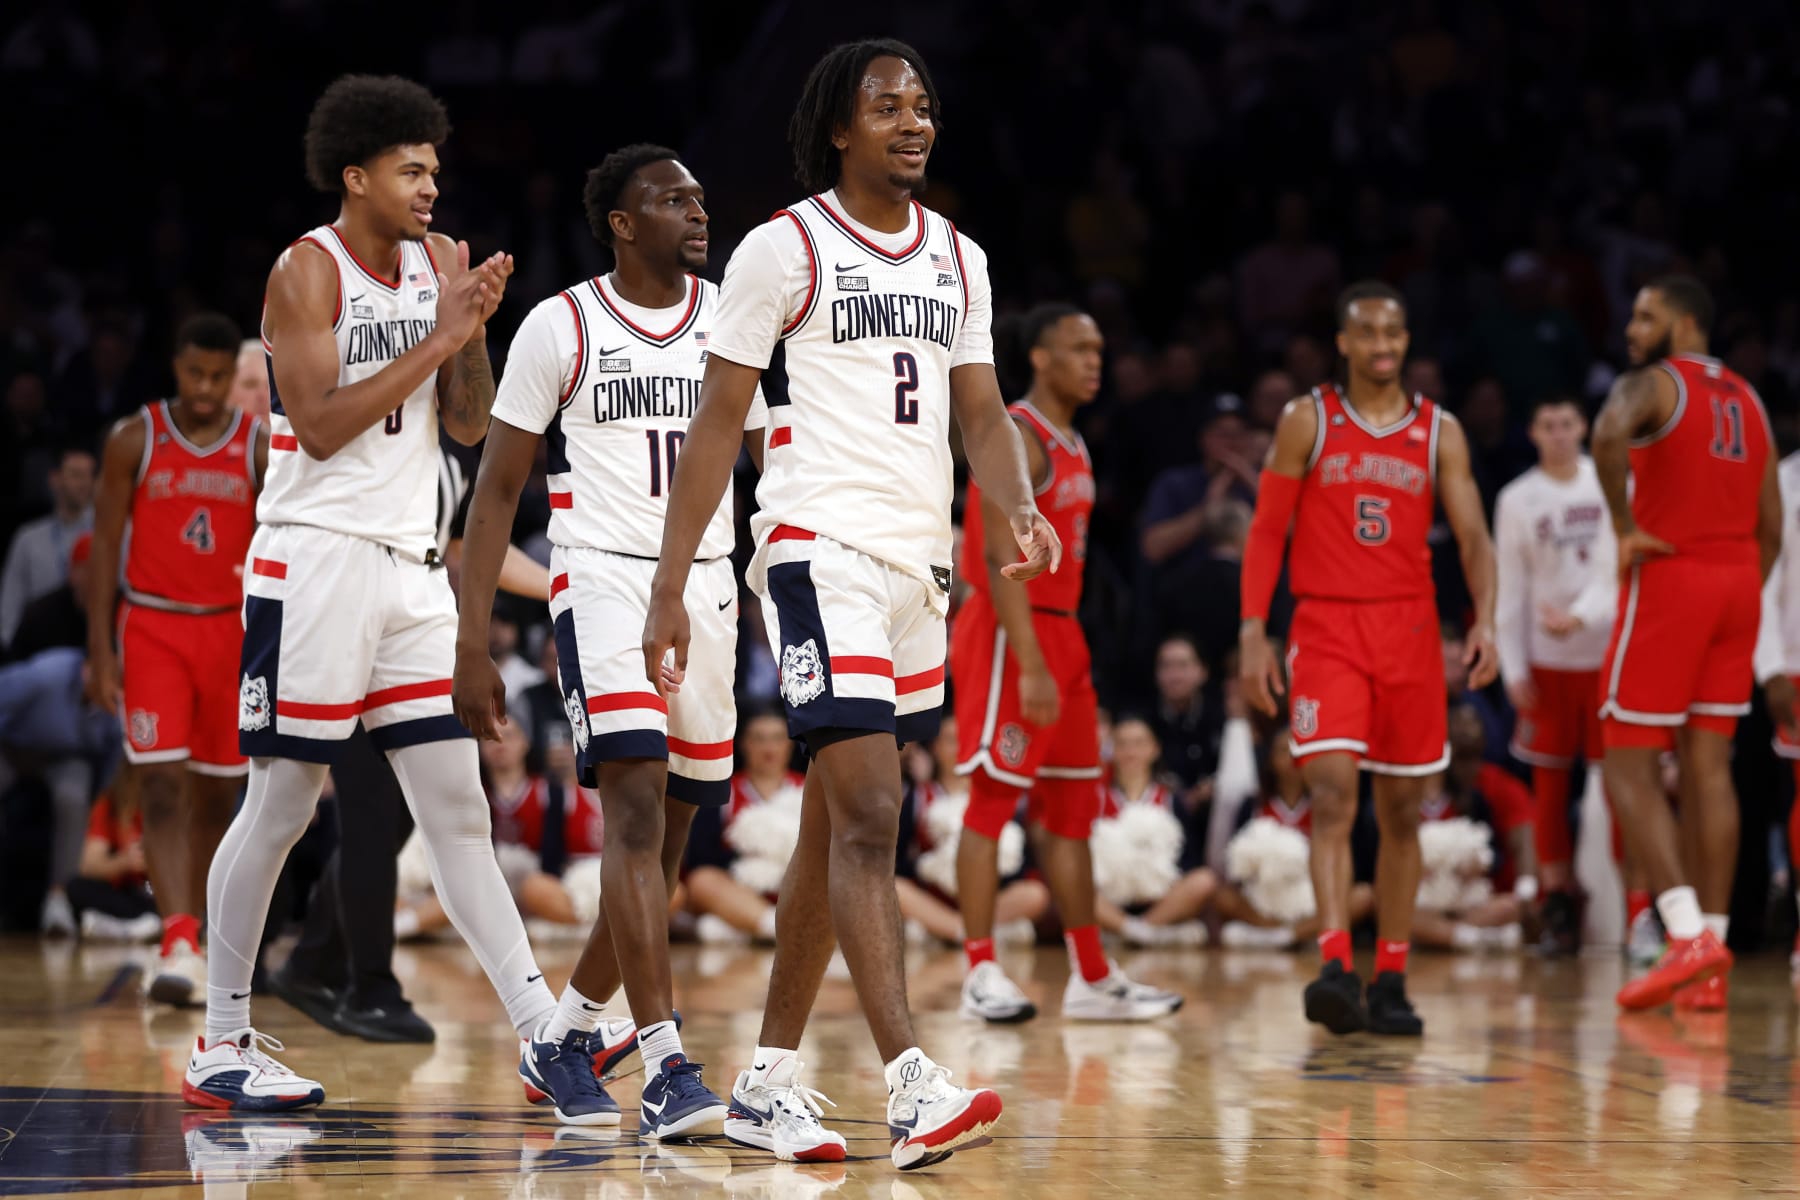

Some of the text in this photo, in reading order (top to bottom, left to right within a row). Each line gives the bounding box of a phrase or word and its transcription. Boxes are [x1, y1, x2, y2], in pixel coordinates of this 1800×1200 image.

[832, 293, 958, 352] CONNECTICUT
[893, 352, 919, 425] 2
[1709, 394, 1747, 463] 11
[179, 506, 216, 555] 4
[1353, 494, 1392, 547] 5
